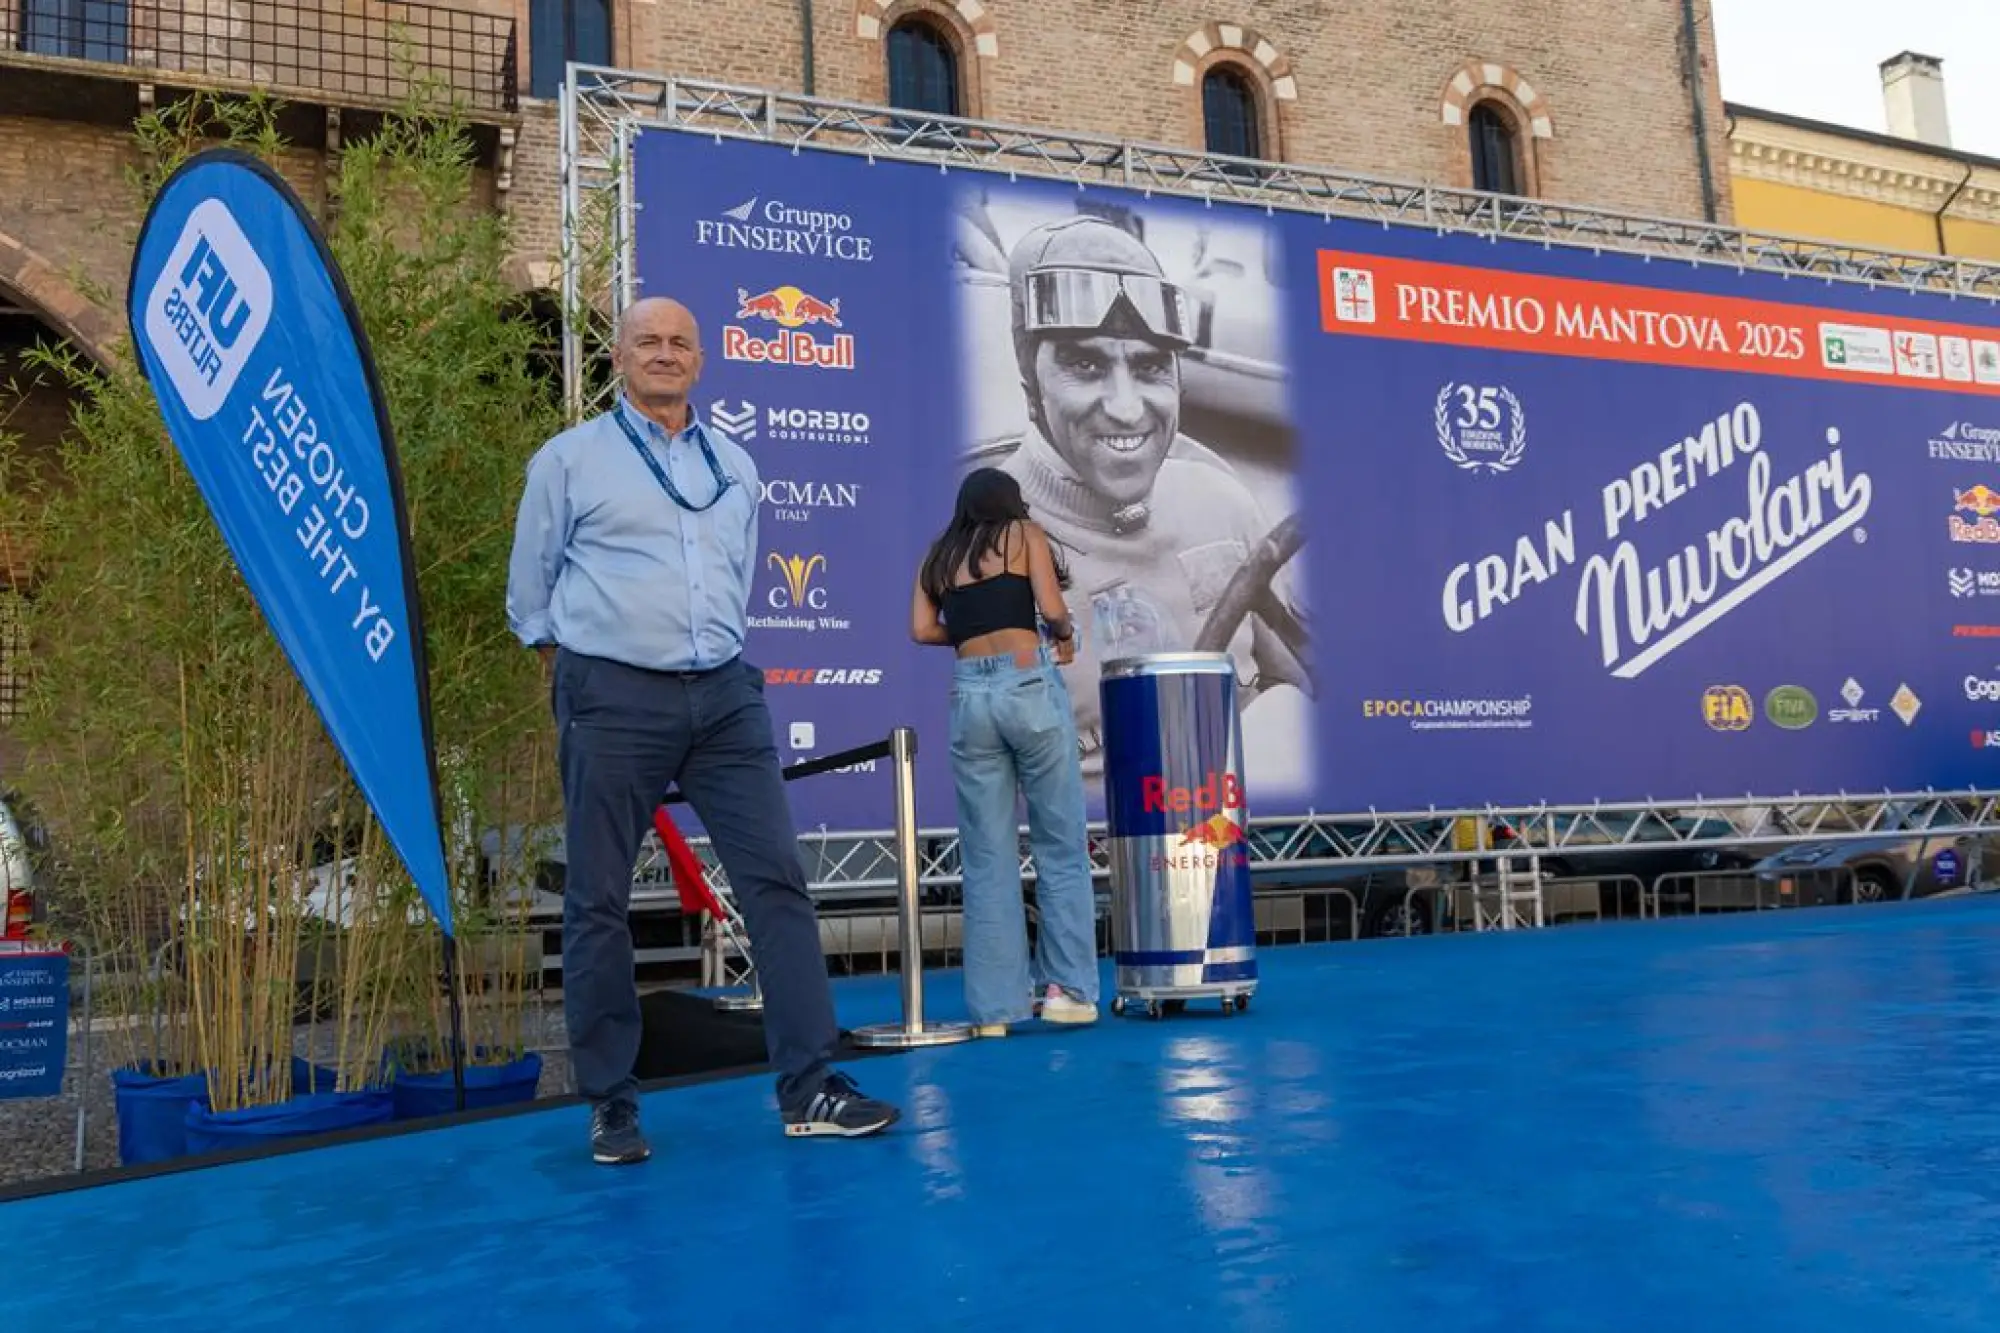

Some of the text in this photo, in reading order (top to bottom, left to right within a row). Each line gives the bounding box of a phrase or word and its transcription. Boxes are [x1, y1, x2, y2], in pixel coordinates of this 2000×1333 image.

[764, 200, 852, 232] Gruppo
[696, 219, 874, 262] FINSERVICE
[1395, 283, 1546, 334] PREMIO
[1555, 304, 1731, 354] MANTOVA
[1736, 320, 1806, 360] 2025
[723, 325, 854, 369] Red Bull
[767, 407, 870, 432] MORBIO
[1457, 384, 1501, 429] 35
[768, 430, 871, 444] COSTRUZIONI
[774, 509, 811, 522] ITALY
[1442, 401, 1762, 632] GRAN PREMIO
[1575, 426, 1872, 679] Nuvolari
[747, 615, 851, 632] Rethinking Wine
[763, 667, 882, 685] SKECARS
[1704, 695, 1749, 721] FIA
[1142, 771, 1218, 813] Red
